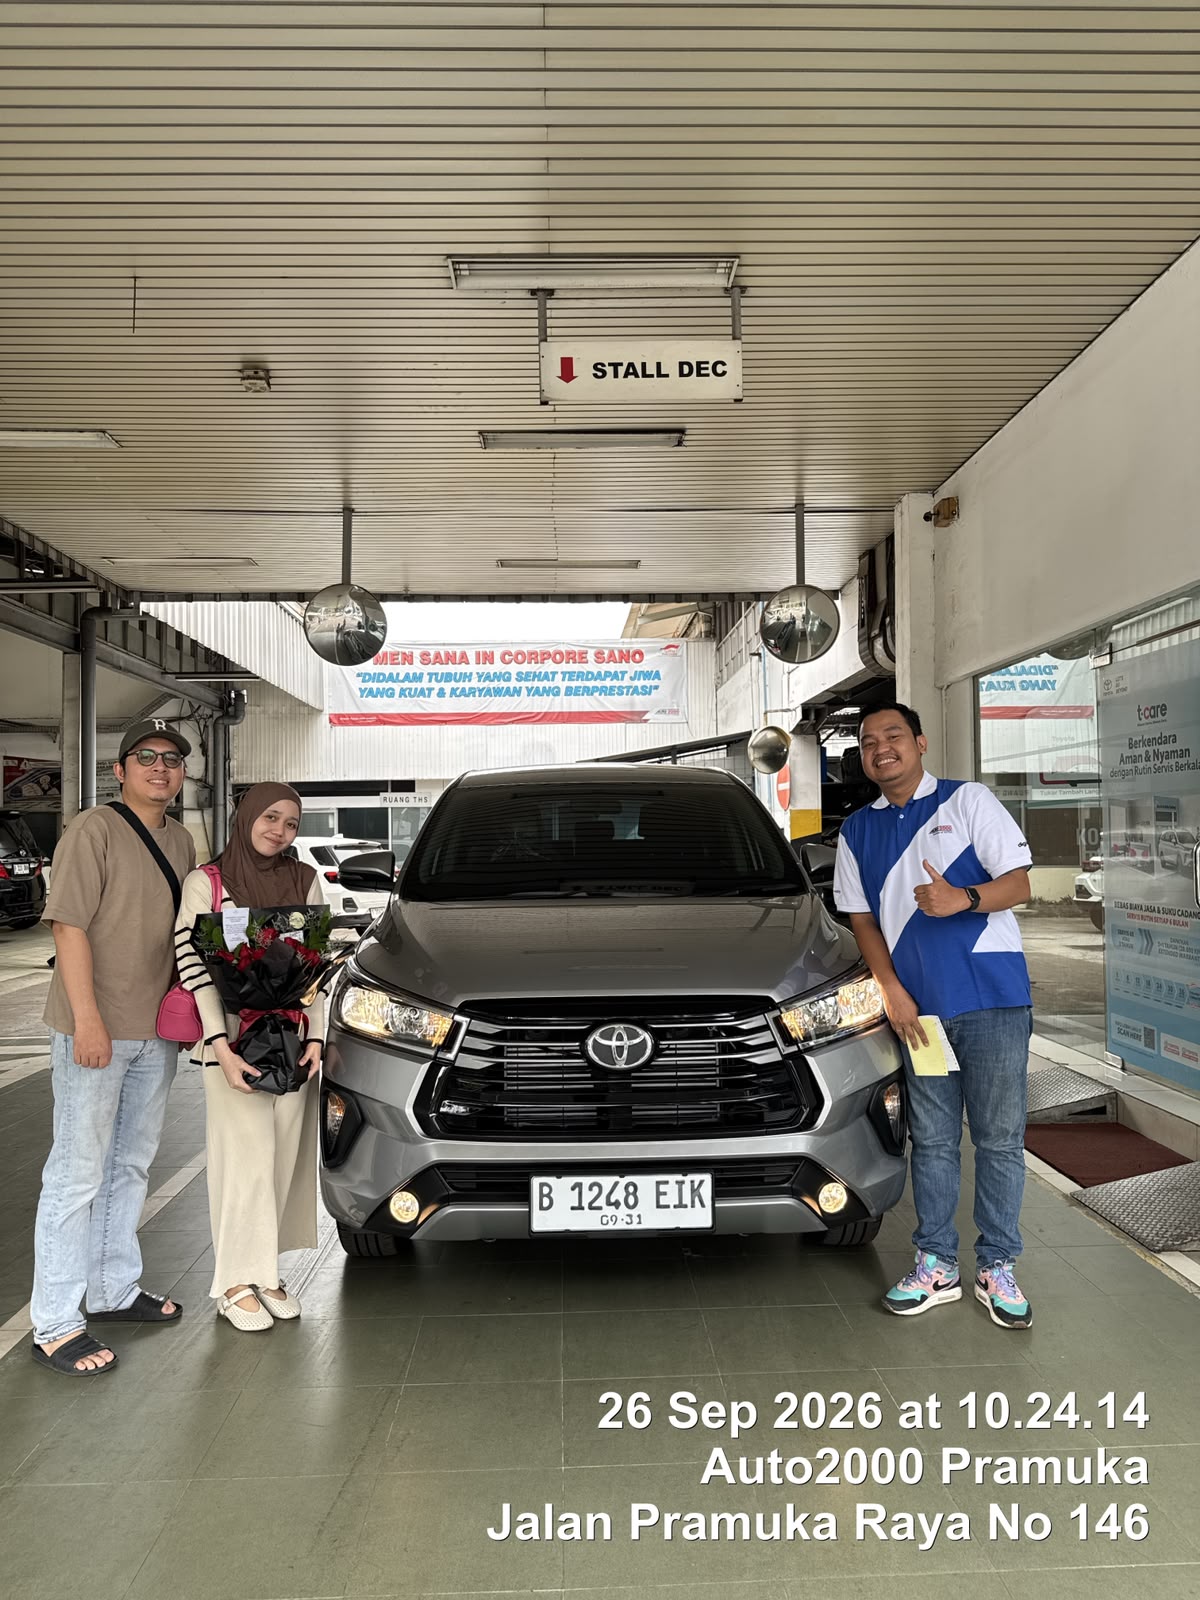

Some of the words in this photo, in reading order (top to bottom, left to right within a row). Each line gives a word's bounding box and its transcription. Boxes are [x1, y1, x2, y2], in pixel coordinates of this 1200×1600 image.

[592, 361, 670, 379] STALL
[678, 360, 727, 378] DEC
[373, 650, 414, 665] MEN
[419, 650, 470, 665] SANA
[475, 650, 495, 665] IN
[500, 649, 588, 664] CORPORE
[594, 648, 644, 664] SANO
[427, 671, 473, 683] TUBUH
[476, 671, 512, 683] YANG
[515, 670, 558, 682] SEHAT
[561, 670, 628, 682] TERDAPAT
[630, 670, 661, 681] JIWA
[359, 686, 395, 698] YANG
[399, 686, 435, 698] KUAT
[436, 687, 446, 698] &
[449, 686, 522, 698] KARYAWAN
[525, 685, 561, 697] YANG
[1128, 732, 1177, 750] Berkendara
[1119, 753, 1143, 765] Aman
[1144, 750, 1151, 763] &
[1152, 748, 1190, 766] Nyaman
[1110, 766, 1134, 780] dengan
[1134, 764, 1152, 776] Rutin
[1153, 762, 1174, 774] Servis
[1144, 905, 1156, 913] JASA
[1162, 907, 1176, 916] SUKU
[1117, 1027, 1129, 1038] SCAN
[1130, 1032, 1142, 1042] HERE
[538, 1182, 554, 1211] B
[570, 1181, 639, 1210] 1248
[655, 1179, 706, 1209] EIK
